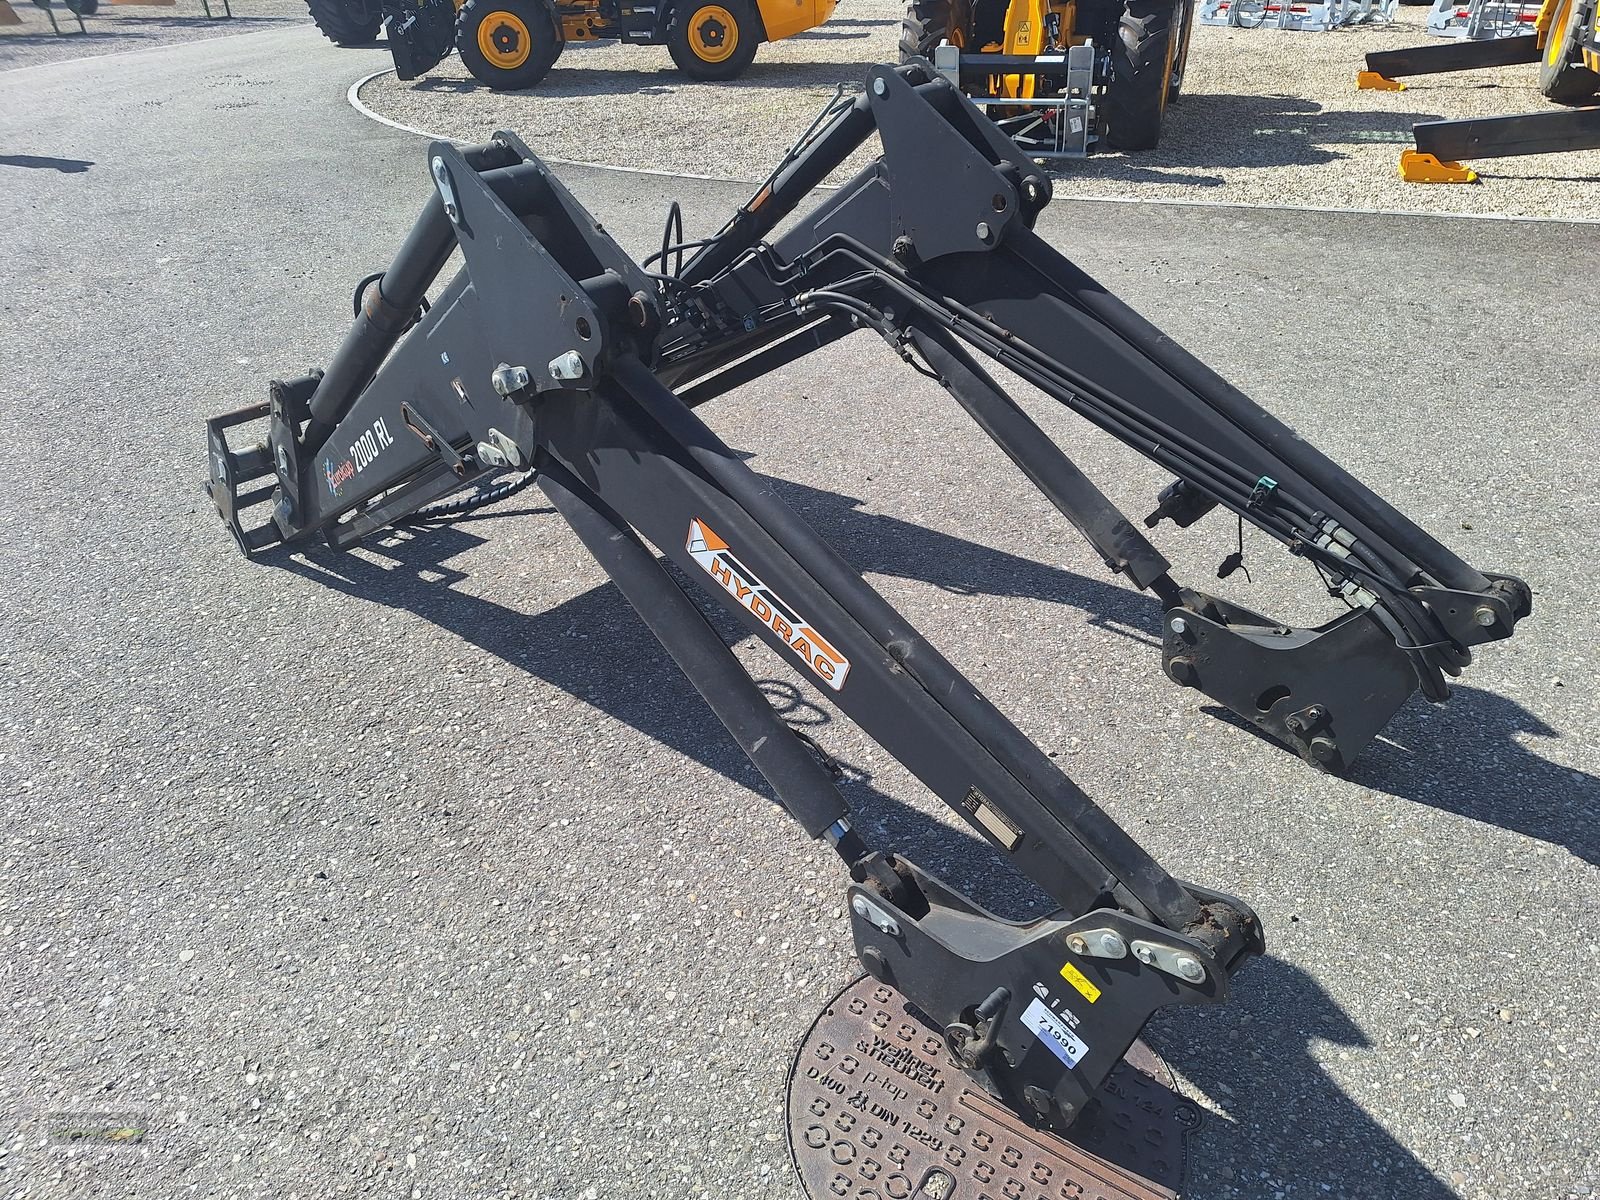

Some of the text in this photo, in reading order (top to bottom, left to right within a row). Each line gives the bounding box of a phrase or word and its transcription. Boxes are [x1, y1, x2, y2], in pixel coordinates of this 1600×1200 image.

[349, 429, 379, 473] 2000
[373, 416, 394, 450] RL
[710, 557, 836, 681] HYDRAC
[1039, 1016, 1077, 1055] 71990
[806, 1066, 944, 1152] D 400 DIN 1229
[862, 1071, 909, 1101] p-top
